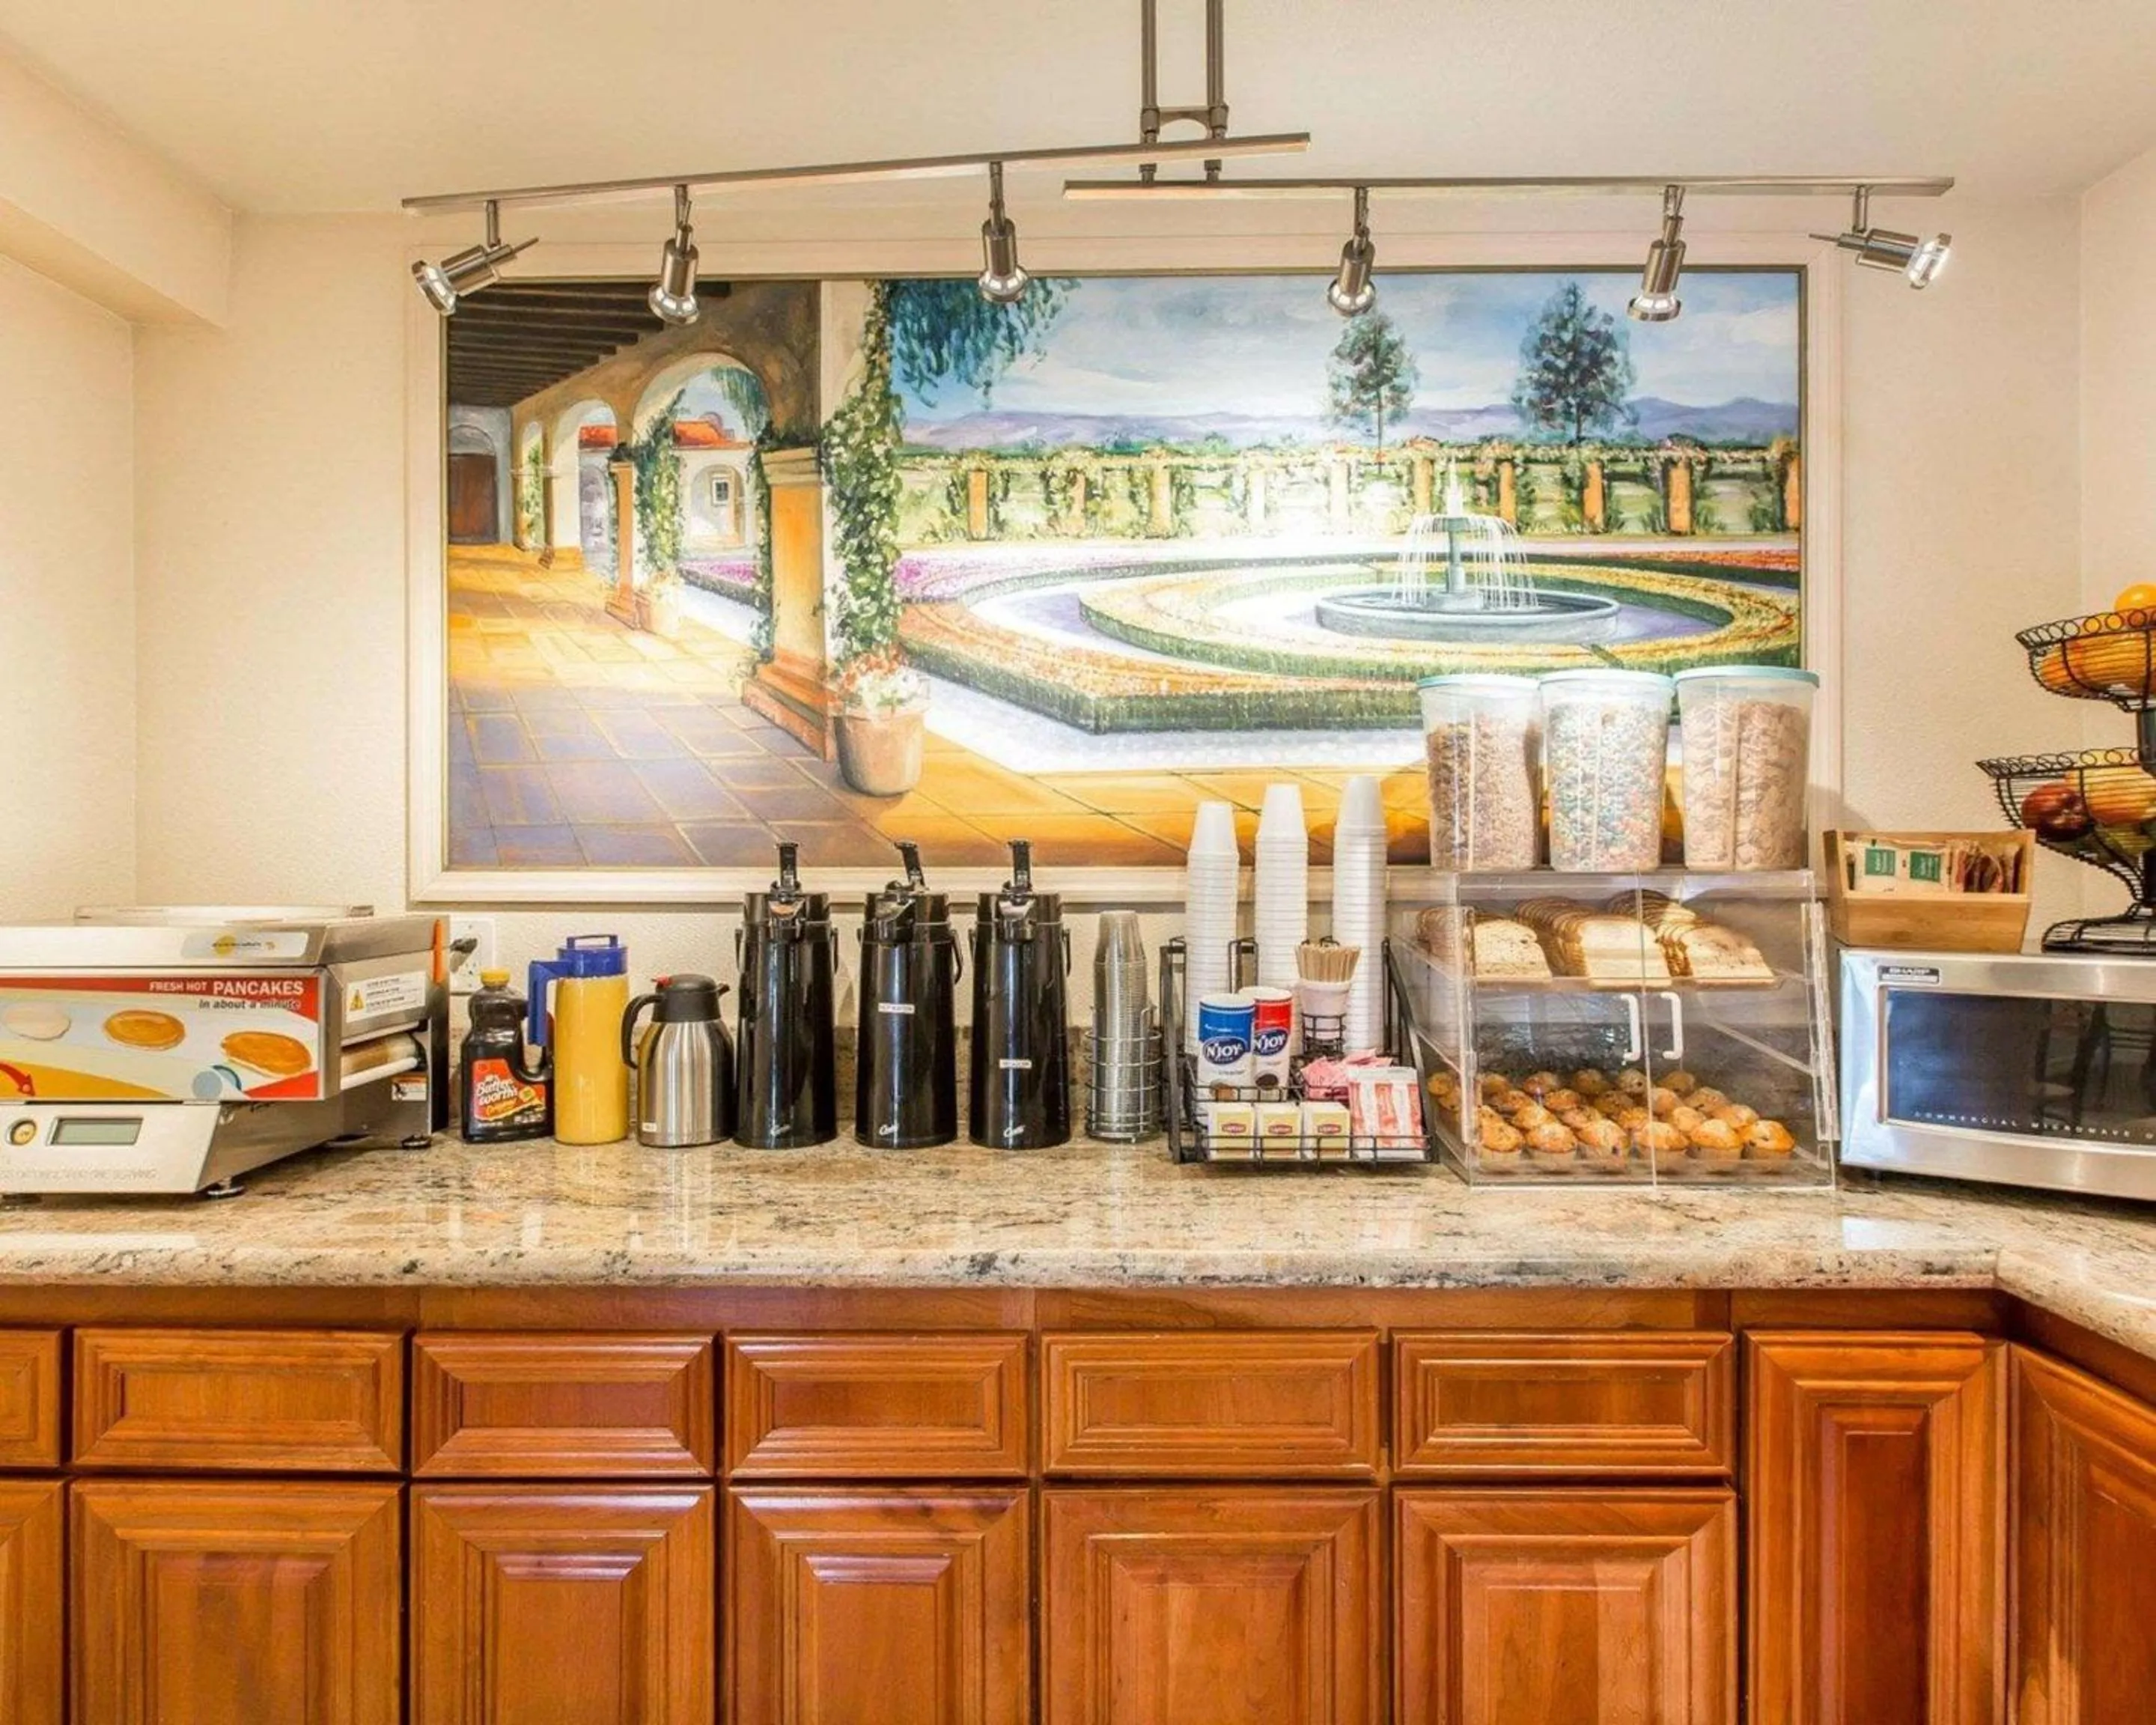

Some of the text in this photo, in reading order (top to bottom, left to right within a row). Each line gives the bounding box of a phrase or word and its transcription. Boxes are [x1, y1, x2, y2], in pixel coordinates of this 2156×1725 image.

[150, 980, 304, 996] FRESH HOT PANCAKES
[199, 1000, 210, 1009] in
[213, 1000, 246, 1009] about
